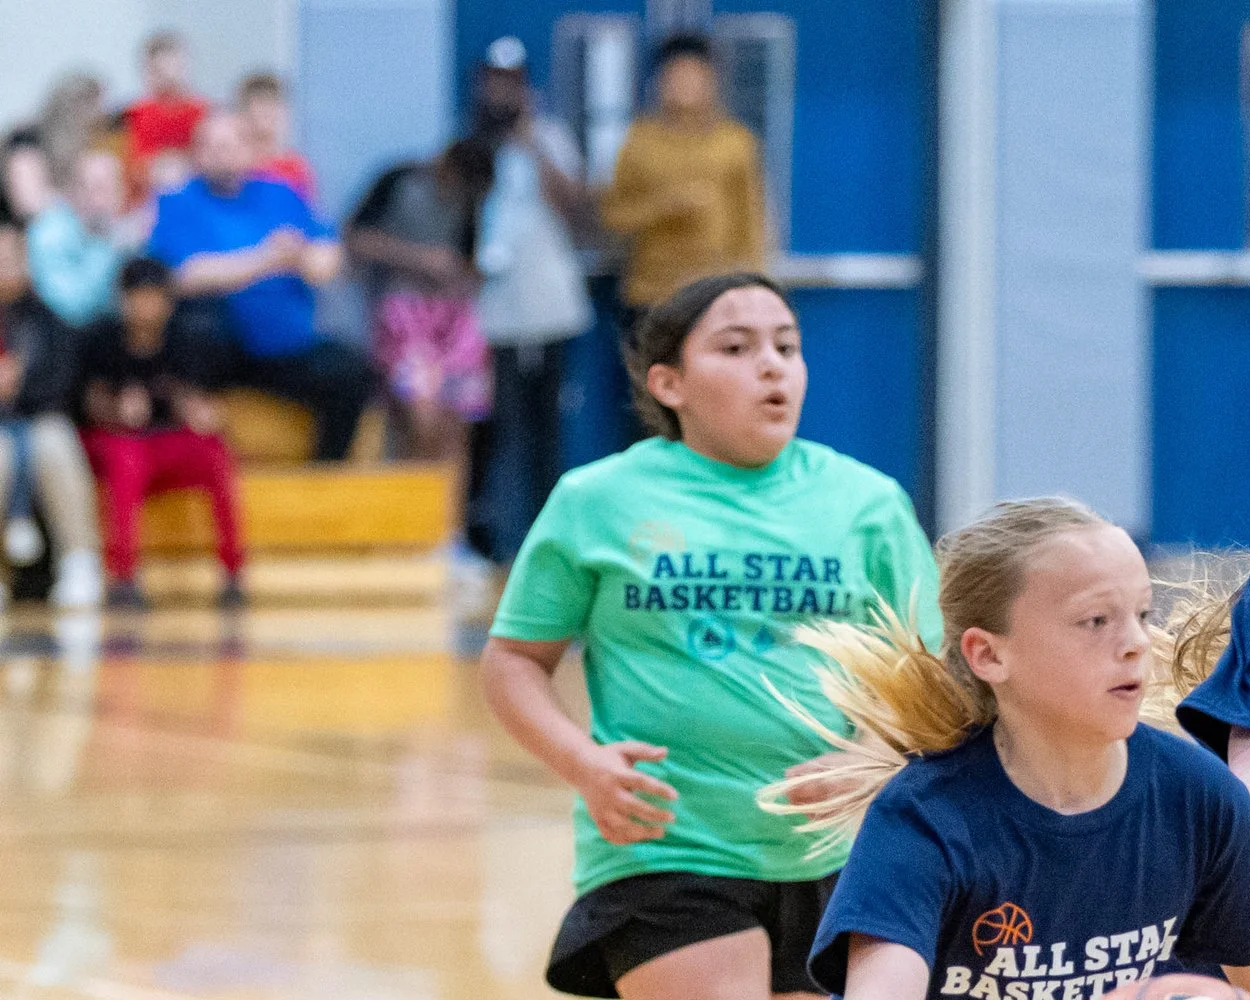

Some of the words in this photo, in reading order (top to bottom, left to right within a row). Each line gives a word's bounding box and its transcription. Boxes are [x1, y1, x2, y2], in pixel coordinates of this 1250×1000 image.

[653, 553, 728, 579] ALL
[743, 554, 842, 584] STAR
[985, 941, 1075, 978] ALL
